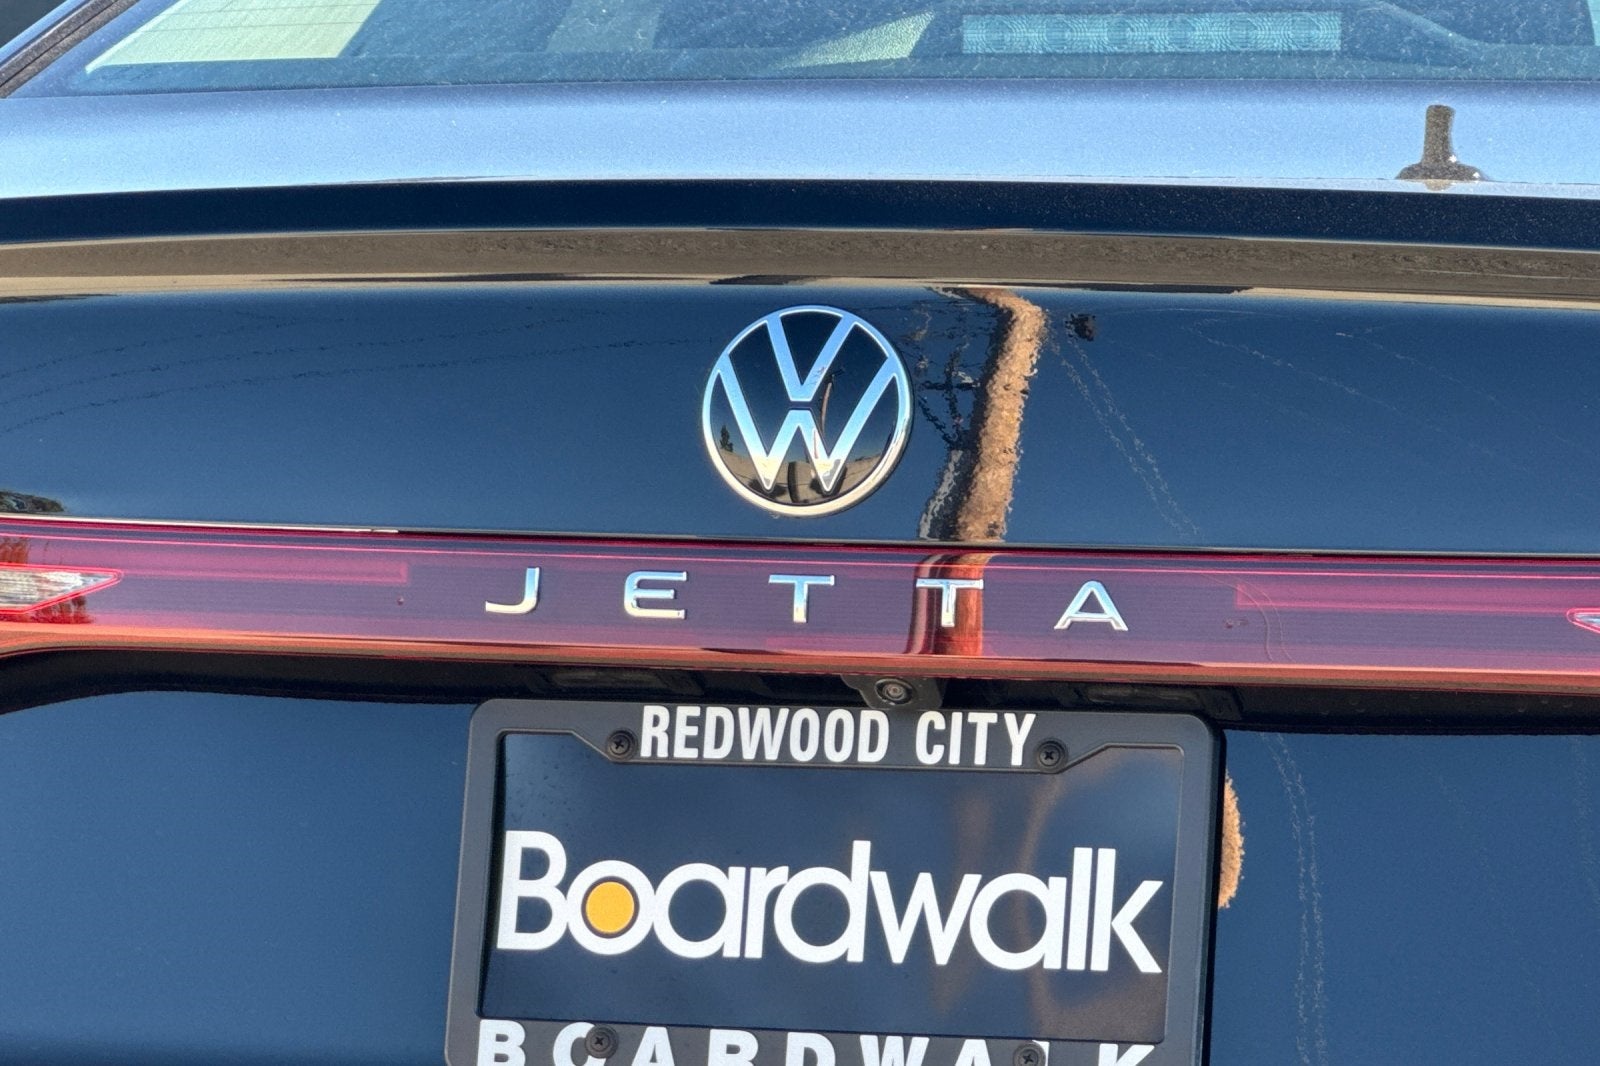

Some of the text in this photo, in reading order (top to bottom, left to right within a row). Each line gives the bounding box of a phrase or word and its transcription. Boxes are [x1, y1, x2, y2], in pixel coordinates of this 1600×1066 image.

[708, 309, 908, 510] VW
[485, 566, 1129, 632] JETTA
[640, 705, 1036, 767] REDWOOD CITY
[496, 830, 1164, 974] Boardwalk
